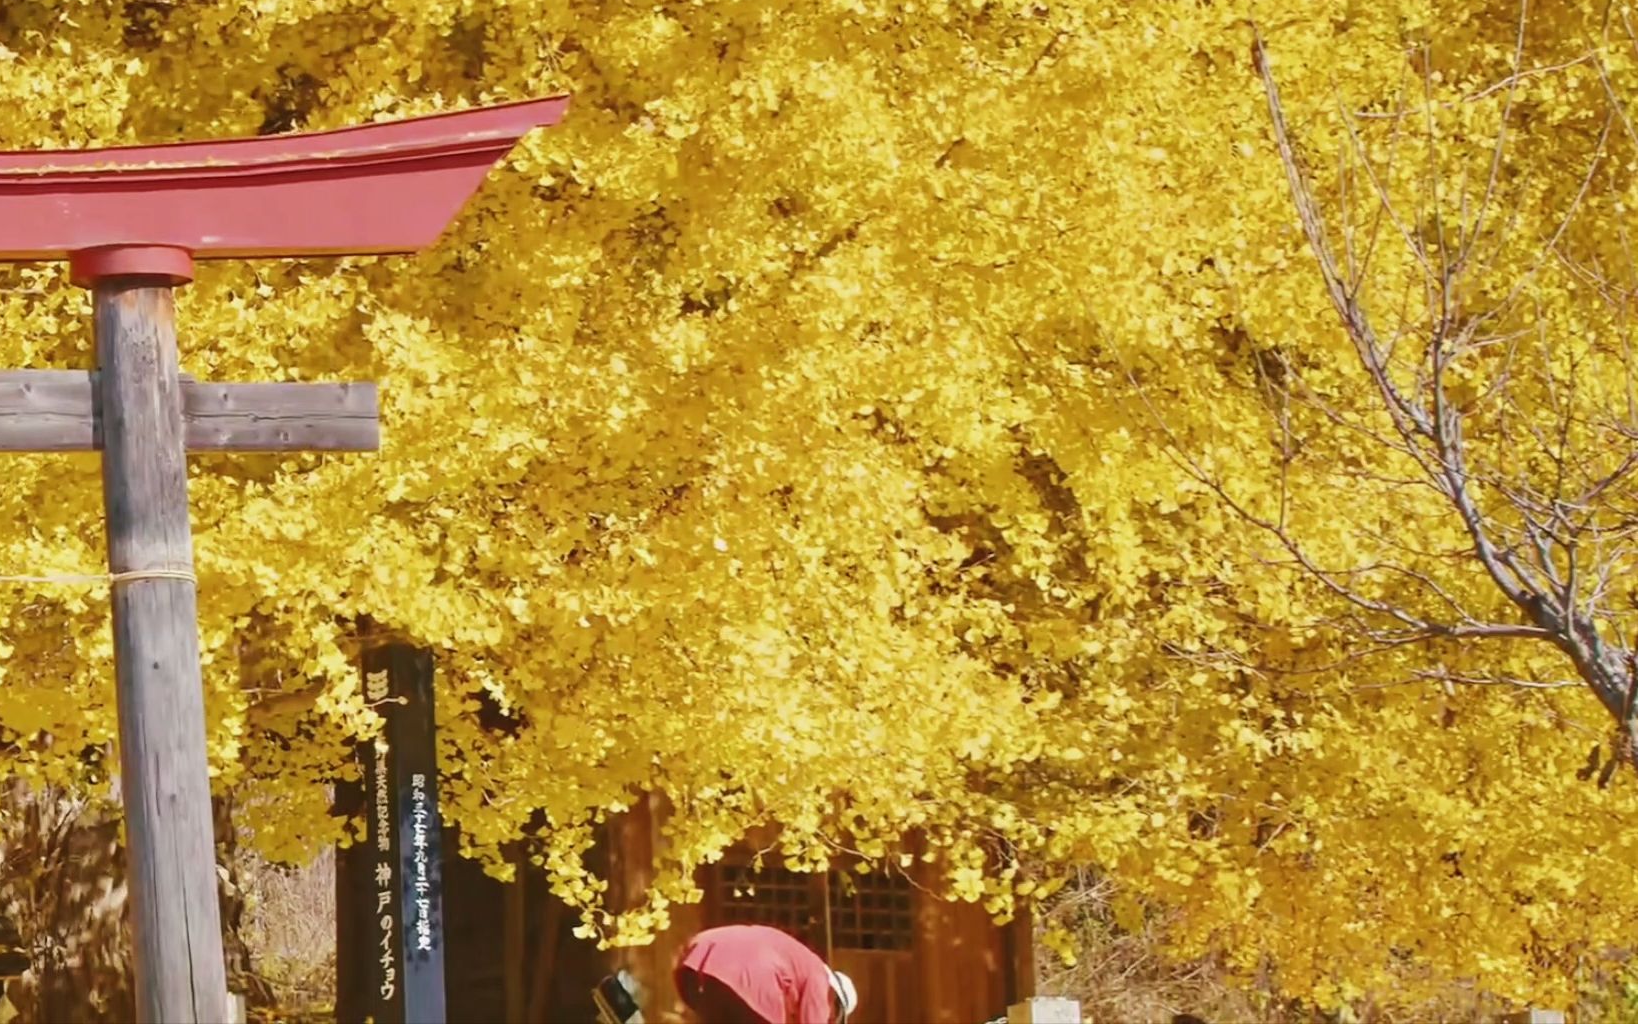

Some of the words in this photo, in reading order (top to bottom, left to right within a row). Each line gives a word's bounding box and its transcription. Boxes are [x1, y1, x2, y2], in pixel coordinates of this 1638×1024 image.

[374, 862, 396, 1001] 神戸のイチョウ
